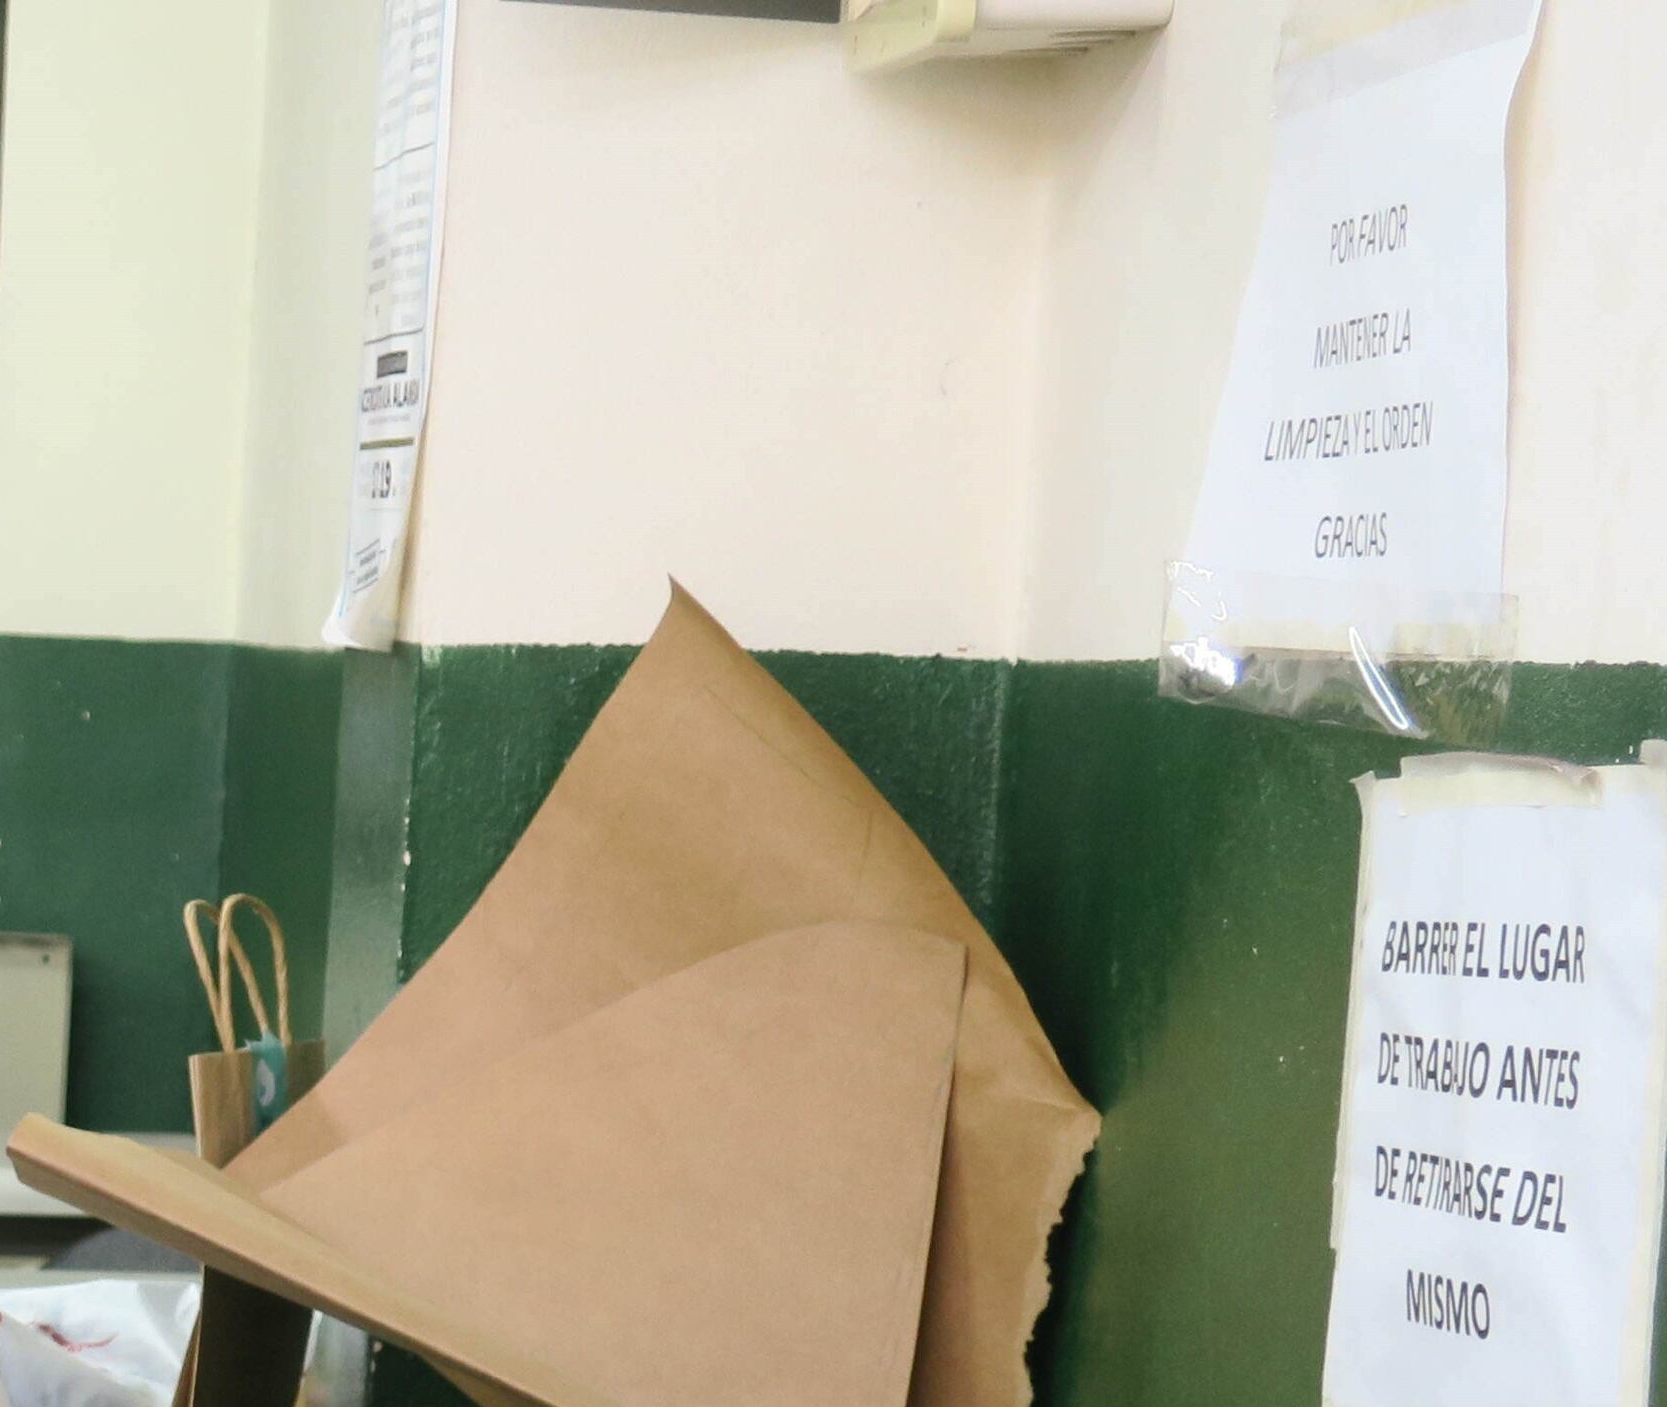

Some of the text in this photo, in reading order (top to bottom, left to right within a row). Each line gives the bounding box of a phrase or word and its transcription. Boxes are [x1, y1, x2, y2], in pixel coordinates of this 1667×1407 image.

[1329, 203, 1409, 267] POR FAVOR
[1313, 307, 1412, 369] MANTENER LA
[1263, 401, 1434, 463] LIMPIEZA Y EL ORDEN
[1313, 511, 1389, 560] GRACIAS
[1380, 920, 1587, 985] BARRER EL LUGAR
[1377, 1031, 1580, 1111] DE TRABAJO ANTES
[1374, 1145, 1568, 1234] DE RETIRARSE DEL
[1404, 1268, 1491, 1340] MISMO
